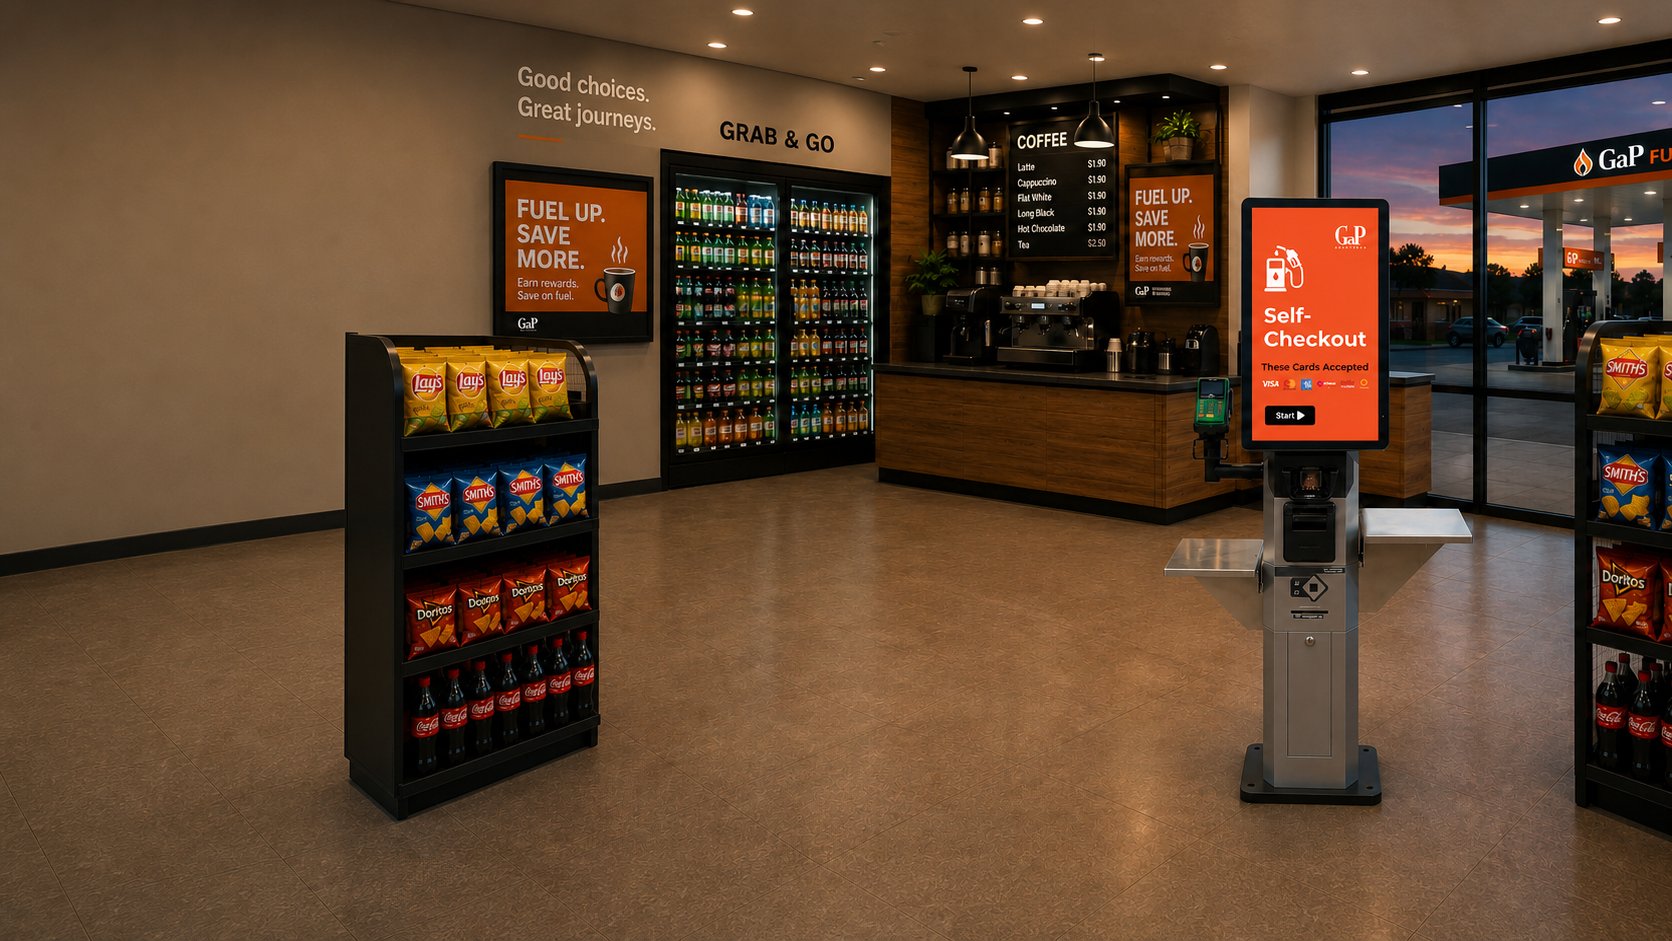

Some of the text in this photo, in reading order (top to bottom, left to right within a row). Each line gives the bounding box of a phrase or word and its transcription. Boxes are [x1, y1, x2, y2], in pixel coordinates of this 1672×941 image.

[518, 66, 650, 102] Good choices.
[518, 96, 656, 134] Great journeys.
[720, 120, 835, 153] GRAB & GO
[1017, 131, 1067, 149] COFFEE
[1017, 158, 1107, 172] Latte $1.90
[1598, 144, 1645, 171] GaP
[1017, 174, 1107, 189] Cappuccino $1.90
[1017, 191, 1107, 203] Flat White $1.90
[1135, 187, 1193, 206] FUEL UP.
[517, 198, 606, 223] FUEL UP.
[1017, 206, 1107, 220] Long Black $1.90
[1135, 209, 1169, 227] SAVE
[517, 223, 571, 246] SAVE
[1017, 222, 1107, 234] Hot Chocolate $1.90
[1334, 225, 1367, 246] GaP
[1017, 240, 1030, 250] Tea
[1135, 230, 1178, 248] MORE.
[517, 248, 585, 270] MORE.
[517, 277, 579, 289] Earn rewards.
[517, 290, 575, 301] Save on fuel.
[517, 317, 539, 330] GaP
[1264, 306, 1312, 324] Self-
[1264, 330, 1367, 348] Checkout
[1261, 363, 1369, 373] These Cards Accepted
[1262, 380, 1280, 388] VISA
[1275, 411, 1295, 420] Start
[1602, 569, 1646, 589] Doritos
[417, 605, 452, 620] Doritos
